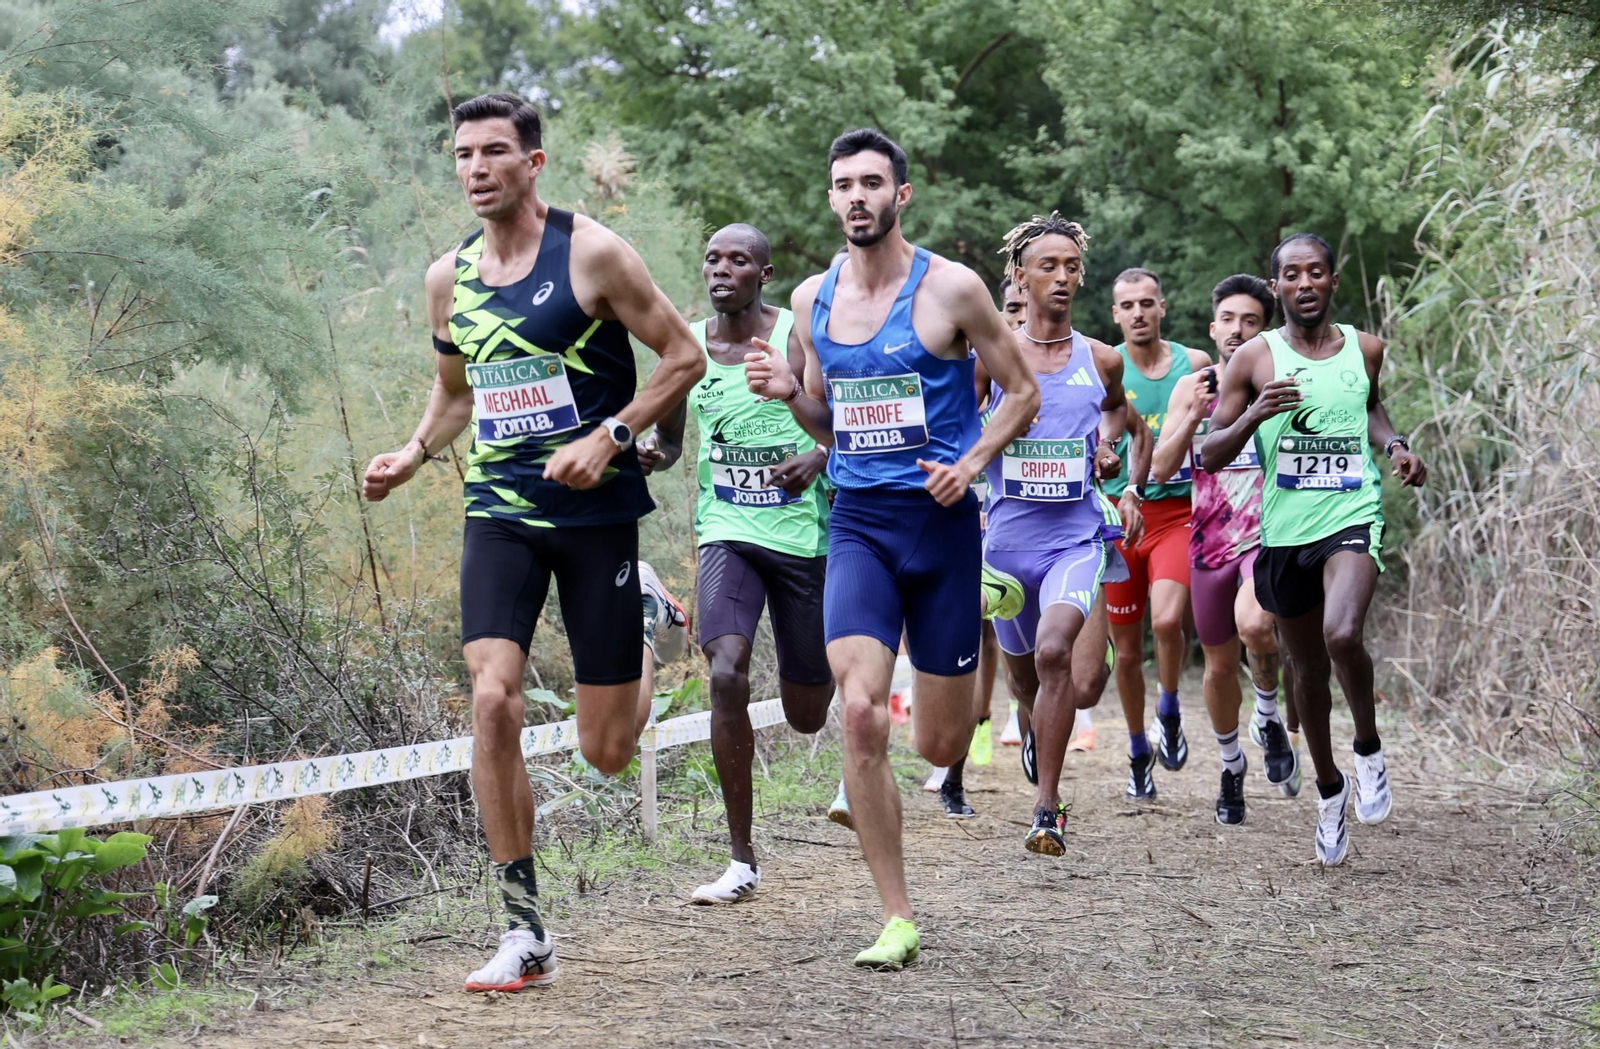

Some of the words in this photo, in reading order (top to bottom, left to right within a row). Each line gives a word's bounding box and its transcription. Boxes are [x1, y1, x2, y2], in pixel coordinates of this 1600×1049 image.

[481, 364, 541, 385] ITÁLICA
[483, 386, 554, 413] MECHAAL
[844, 383, 900, 399] ITÁLICA
[844, 403, 904, 426] CATROFE
[734, 425, 782, 439] MENORCA
[726, 448, 780, 463] ITÁLICA
[1019, 442, 1071, 456] ITÁLICA
[1021, 461, 1067, 479] CRIPPA
[1293, 456, 1349, 474] 1219
[725, 467, 774, 490] 121
